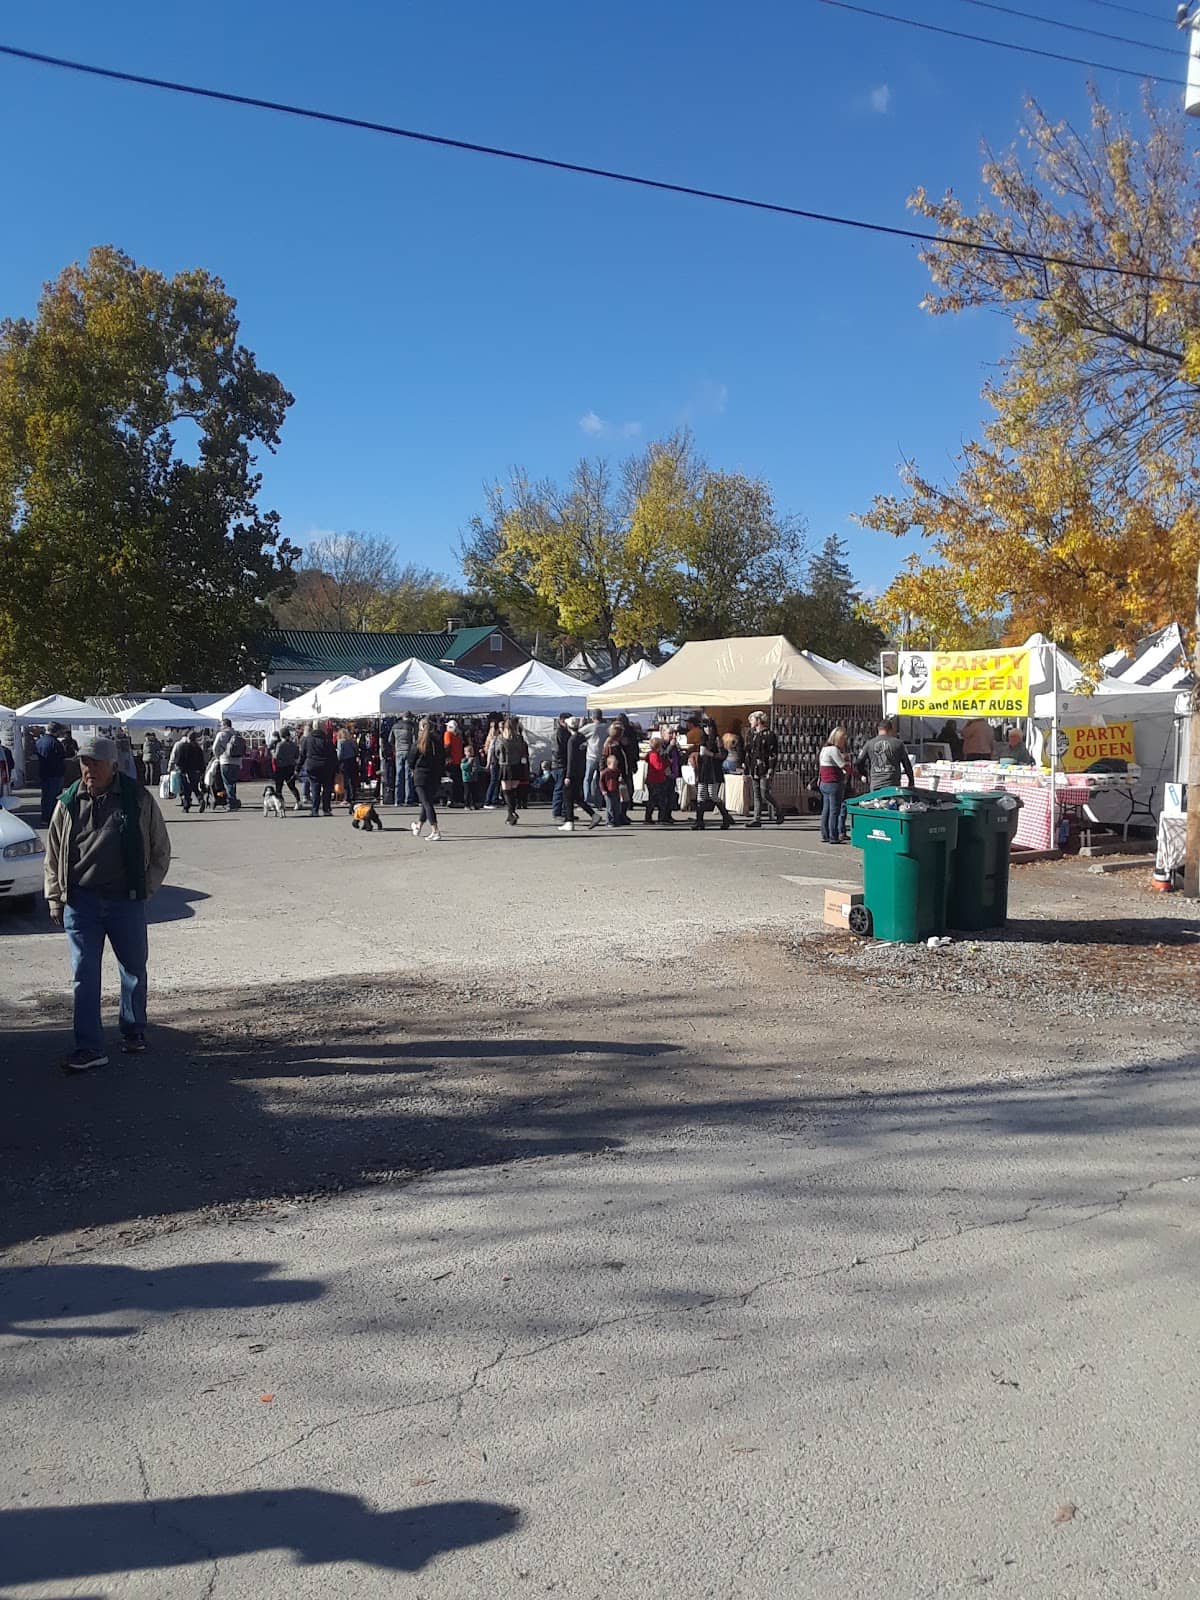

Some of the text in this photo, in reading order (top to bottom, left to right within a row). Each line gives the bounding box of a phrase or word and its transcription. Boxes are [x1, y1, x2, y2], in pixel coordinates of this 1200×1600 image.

[935, 652, 1027, 671] PARTY
[936, 676, 1023, 691] QUEEN
[901, 700, 1023, 711] DIPS and MEAT RUBS
[1076, 726, 1126, 742] PARTY
[1073, 743, 1133, 760] QUEEN
